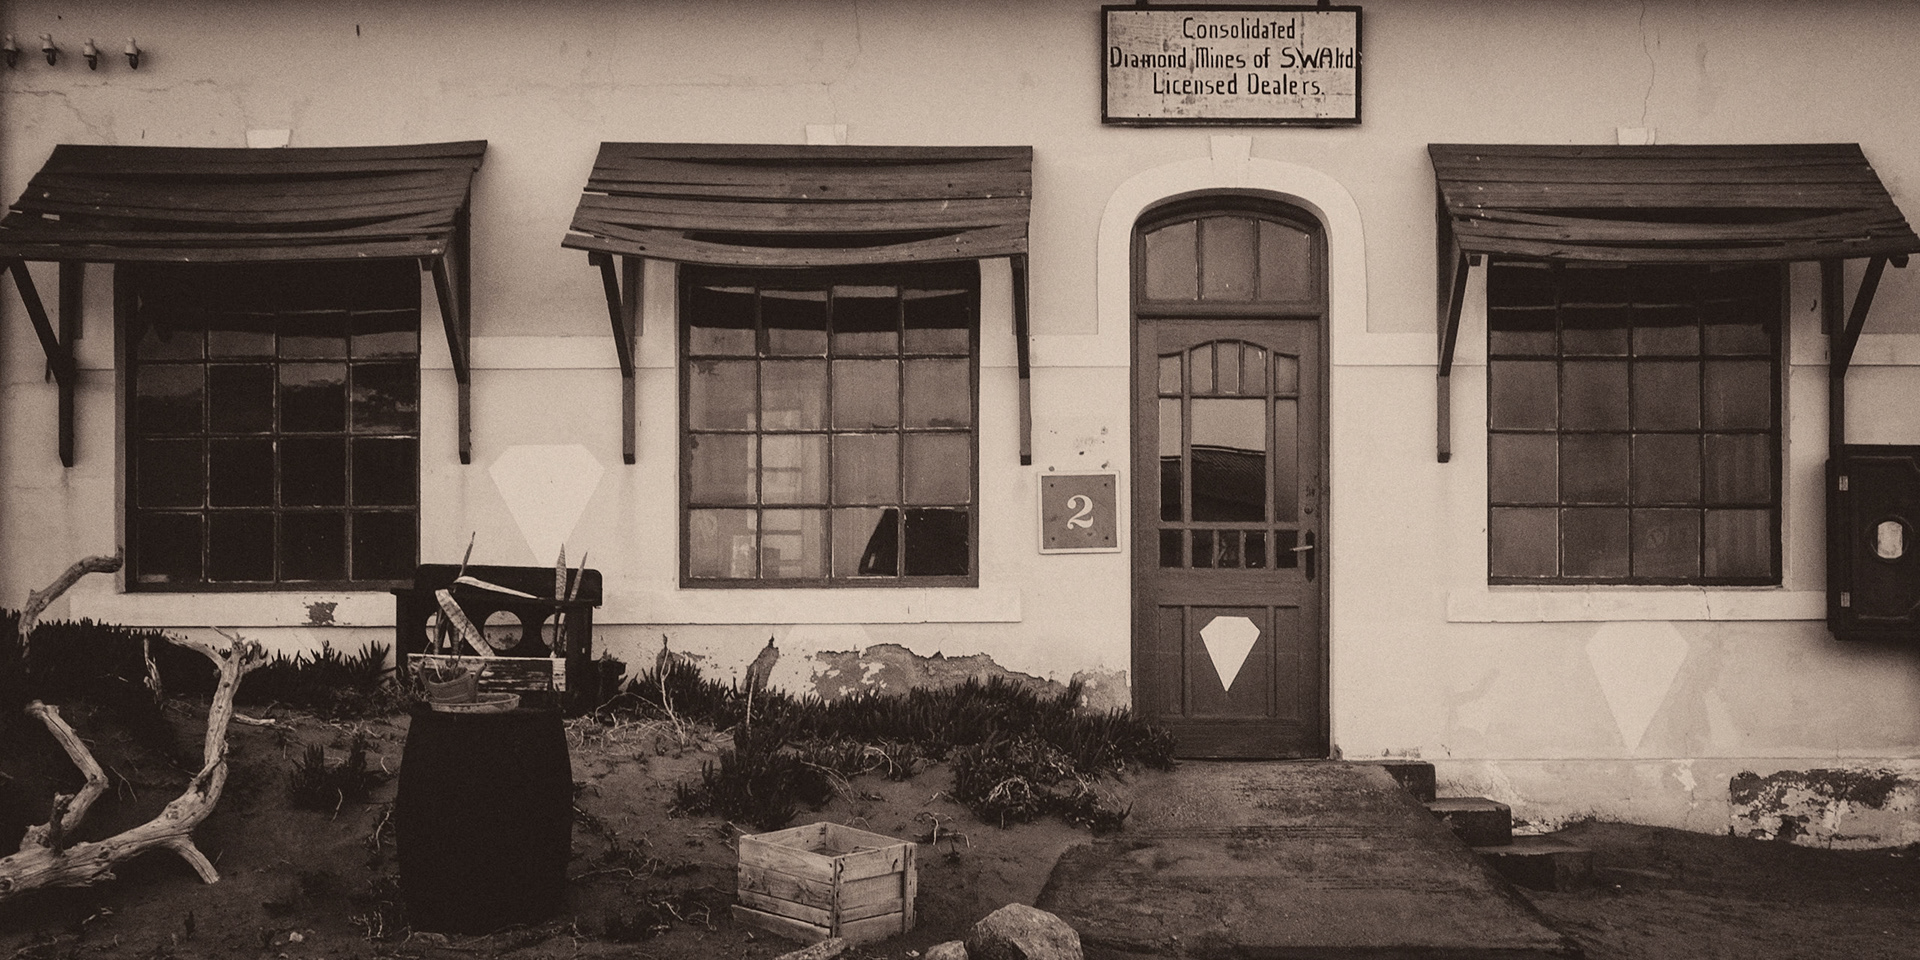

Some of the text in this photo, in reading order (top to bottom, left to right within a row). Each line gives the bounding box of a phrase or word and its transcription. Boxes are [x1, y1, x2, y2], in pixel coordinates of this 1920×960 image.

[1183, 17, 1295, 39] Consolidated
[1110, 46, 1187, 68] Diamond
[1195, 47, 1246, 68] Mines
[1254, 47, 1270, 68] of
[1153, 72, 1325, 95] Licensed Dealers.
[1067, 494, 1094, 530] 2
